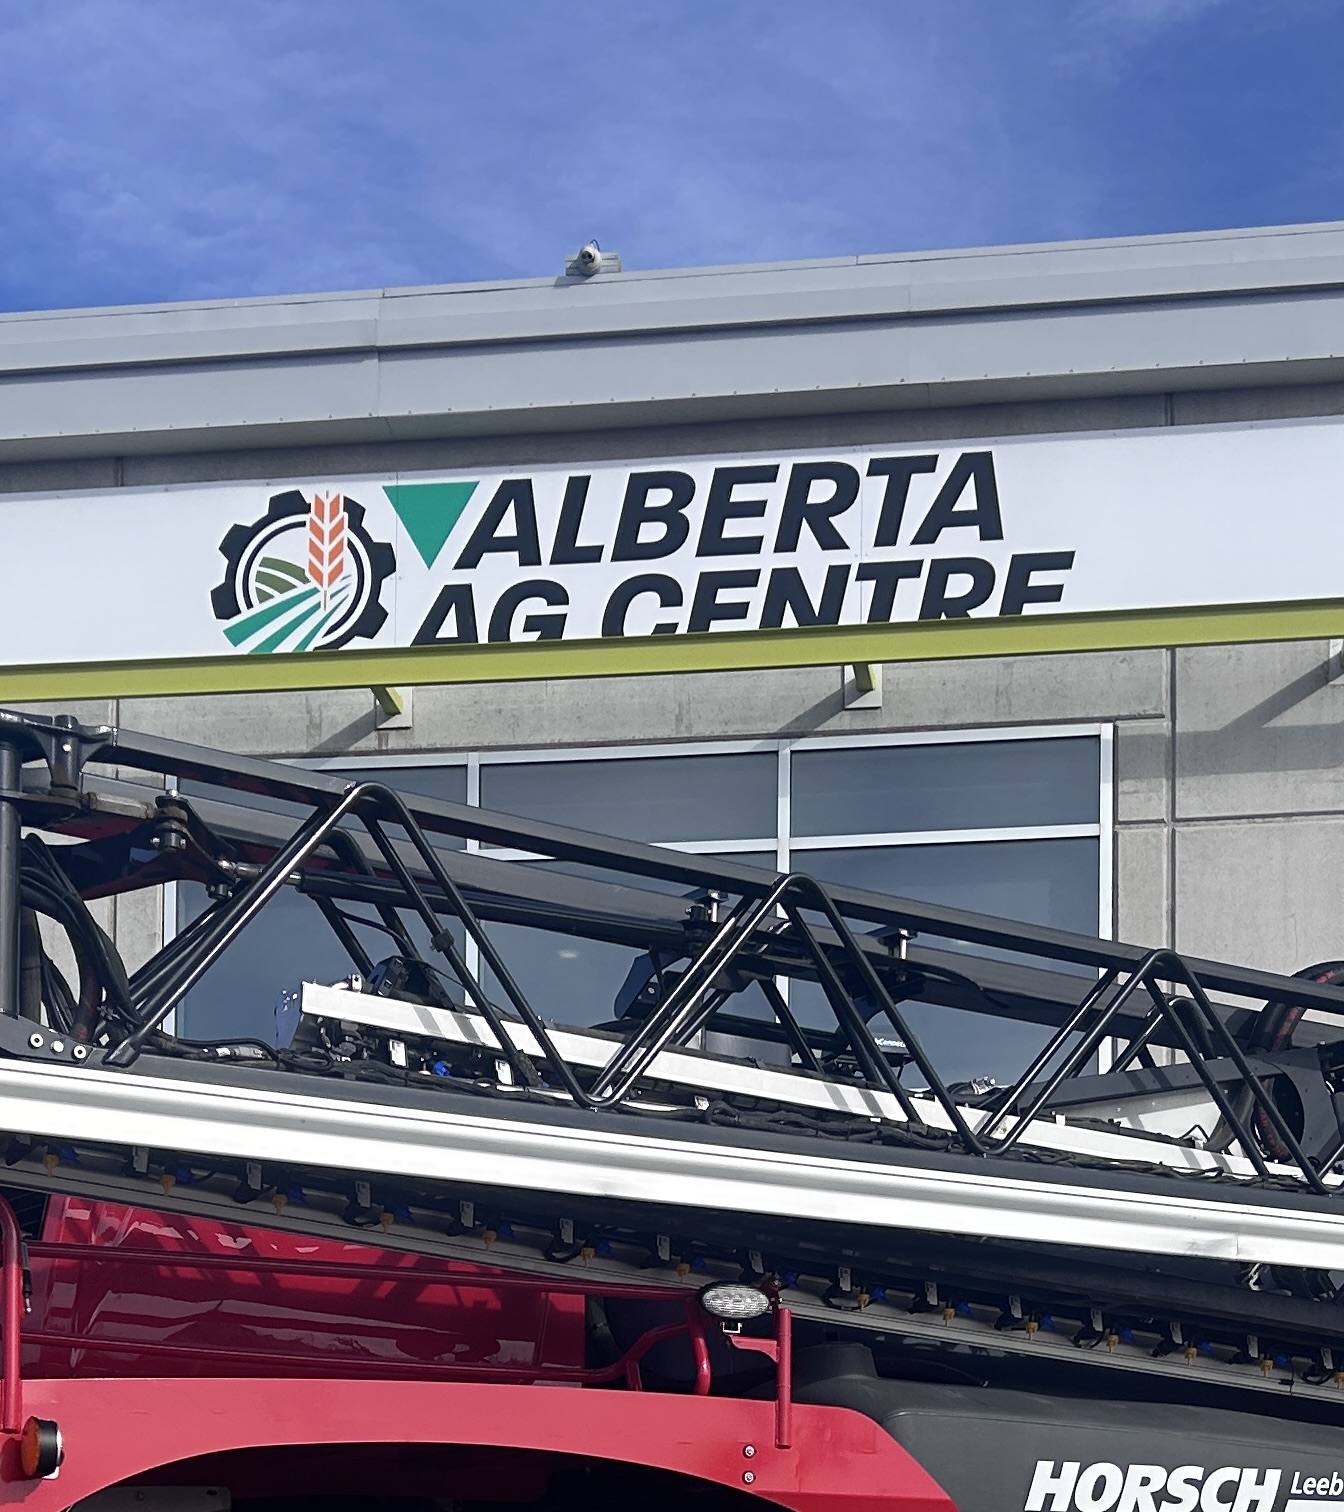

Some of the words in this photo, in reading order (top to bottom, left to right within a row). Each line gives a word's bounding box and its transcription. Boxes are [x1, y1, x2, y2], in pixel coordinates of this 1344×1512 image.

[454, 451, 1004, 570] ALBERTA
[410, 579, 571, 648] AG
[601, 551, 1076, 639] CENTRE
[1290, 1471, 1344, 1497] Leeb
